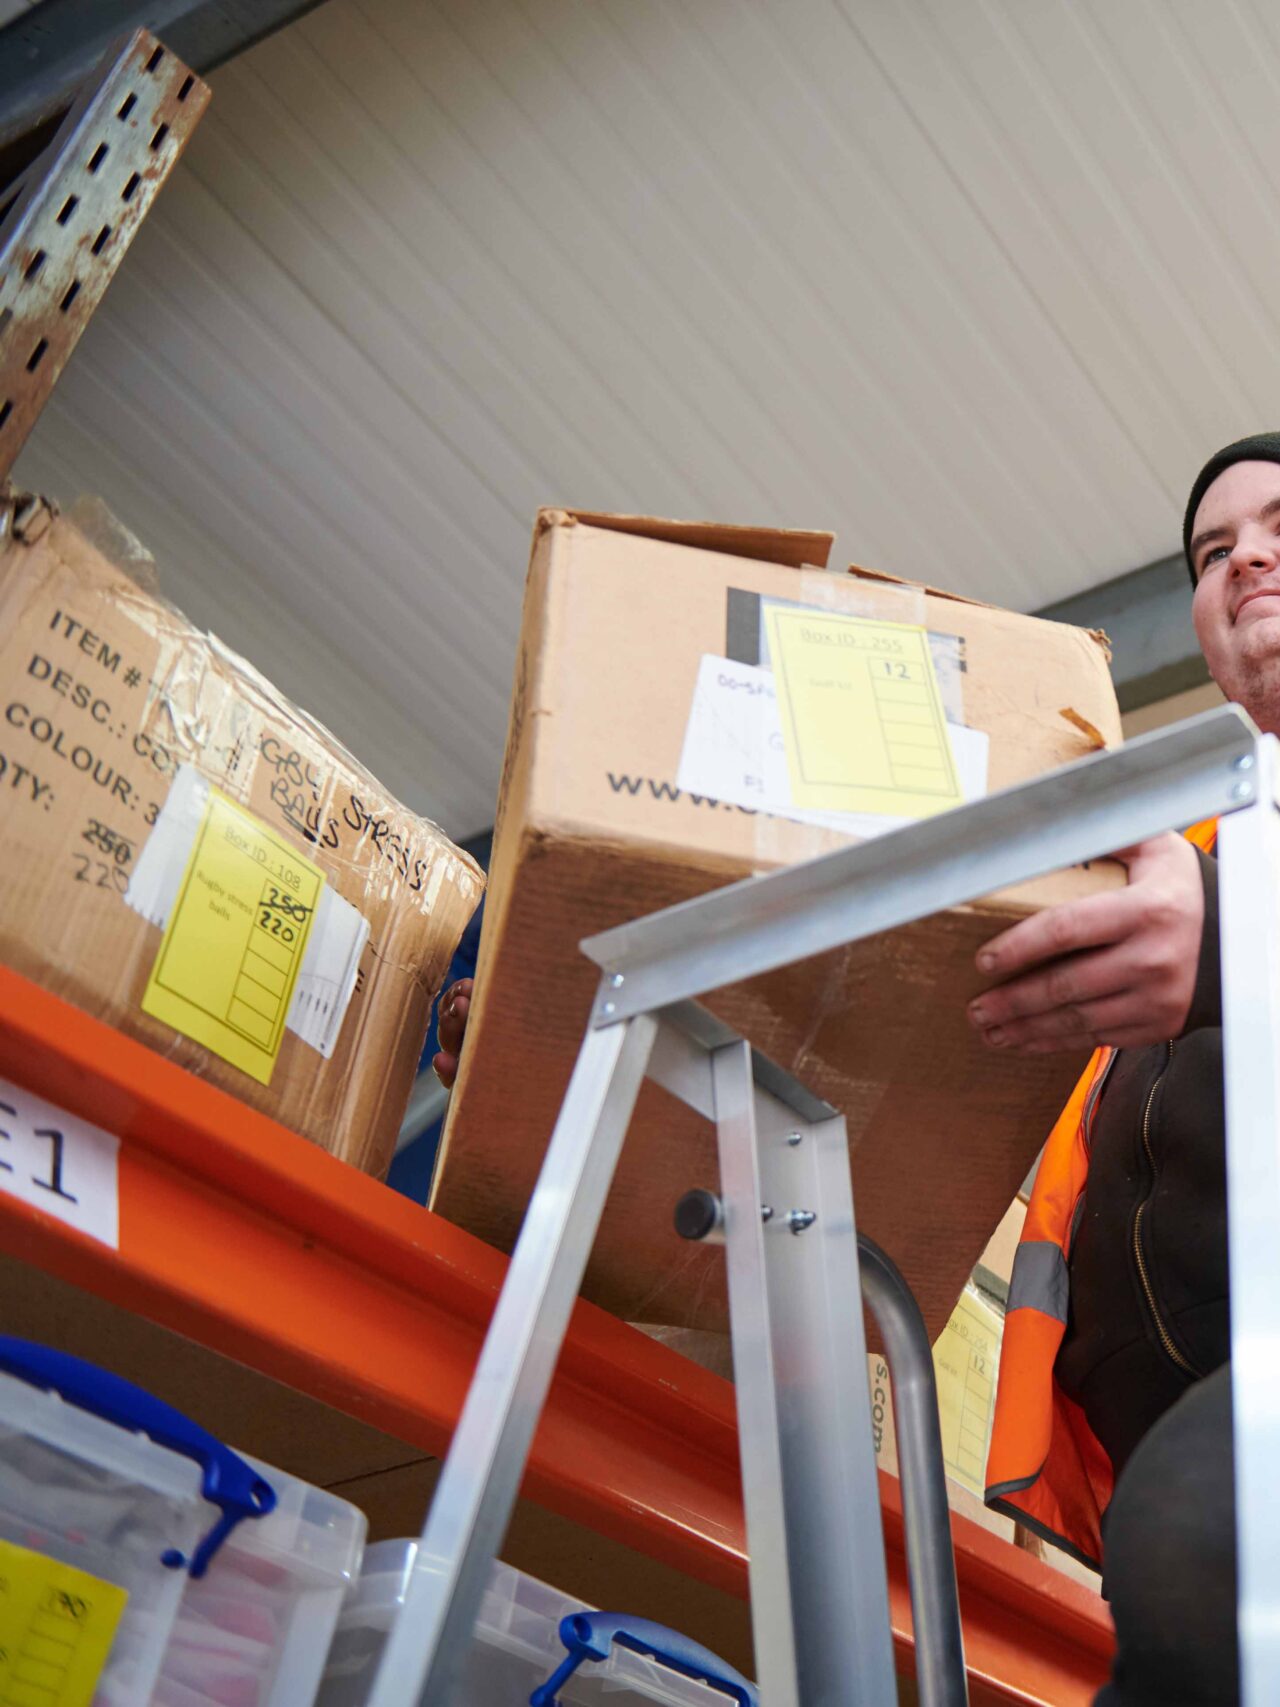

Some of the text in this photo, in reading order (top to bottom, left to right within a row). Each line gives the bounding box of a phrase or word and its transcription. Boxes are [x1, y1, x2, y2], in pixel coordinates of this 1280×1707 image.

[49, 609, 142, 689] ITEM #
[884, 662, 912, 681] 12
[27, 654, 127, 740] DESC.:
[5, 702, 140, 811] COLOUR:
[224, 826, 249, 852] Box
[251, 845, 268, 864] ID
[259, 910, 295, 943] 220
[973, 1354, 986, 1376] 12
